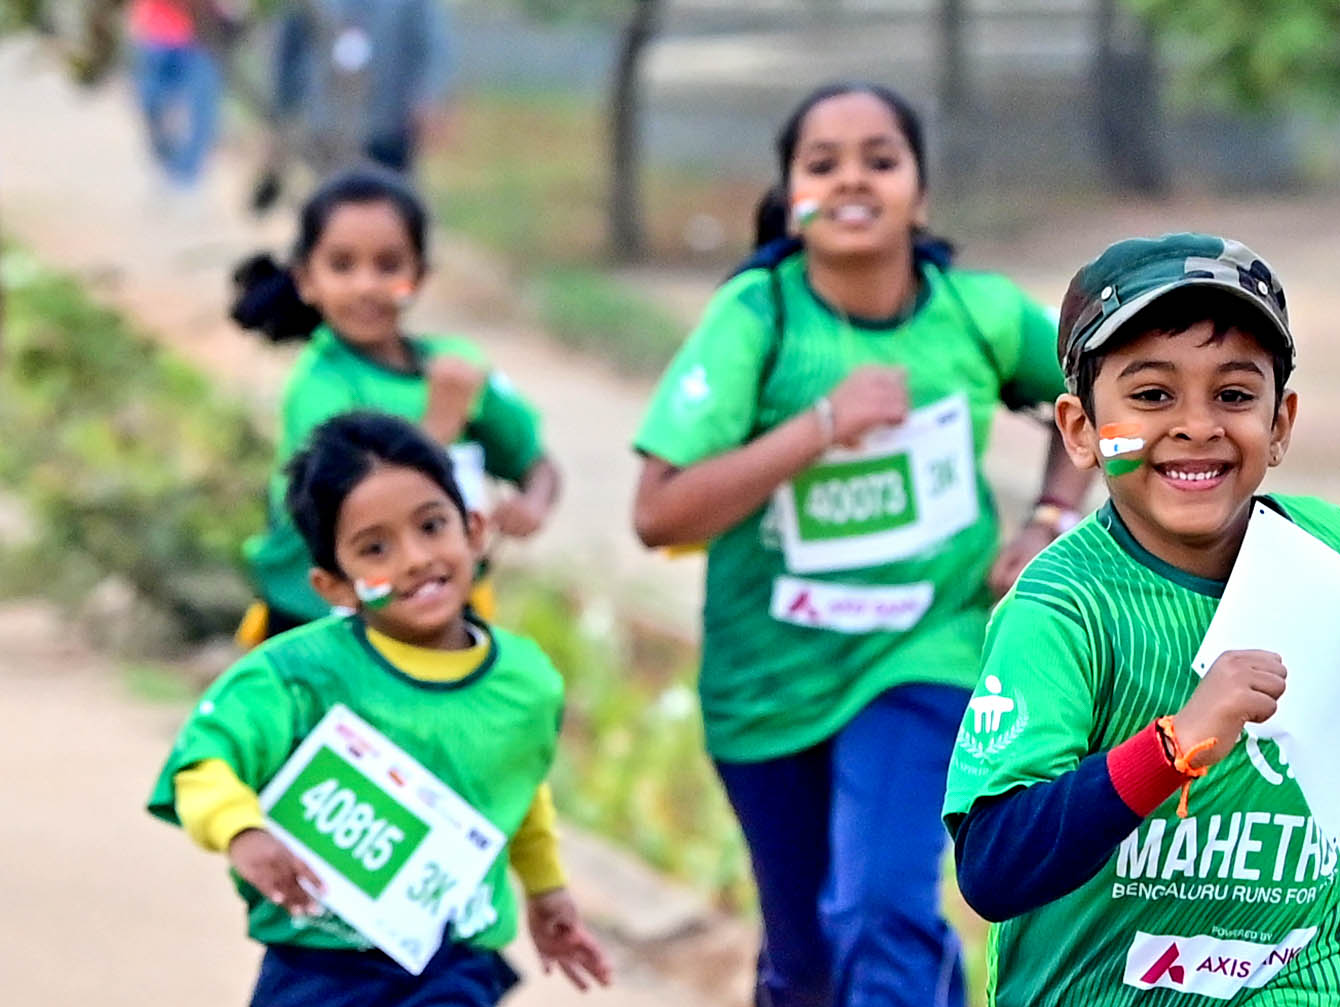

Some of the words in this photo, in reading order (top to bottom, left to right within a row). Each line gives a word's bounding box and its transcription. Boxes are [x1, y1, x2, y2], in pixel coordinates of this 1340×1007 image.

[300, 778, 405, 872] 40815
[406, 860, 457, 915] 3K
[1112, 882, 1228, 901] BENGALURU
[1232, 884, 1282, 904] RUNS
[1285, 886, 1316, 905] FOR
[1196, 955, 1252, 978] AXIS
